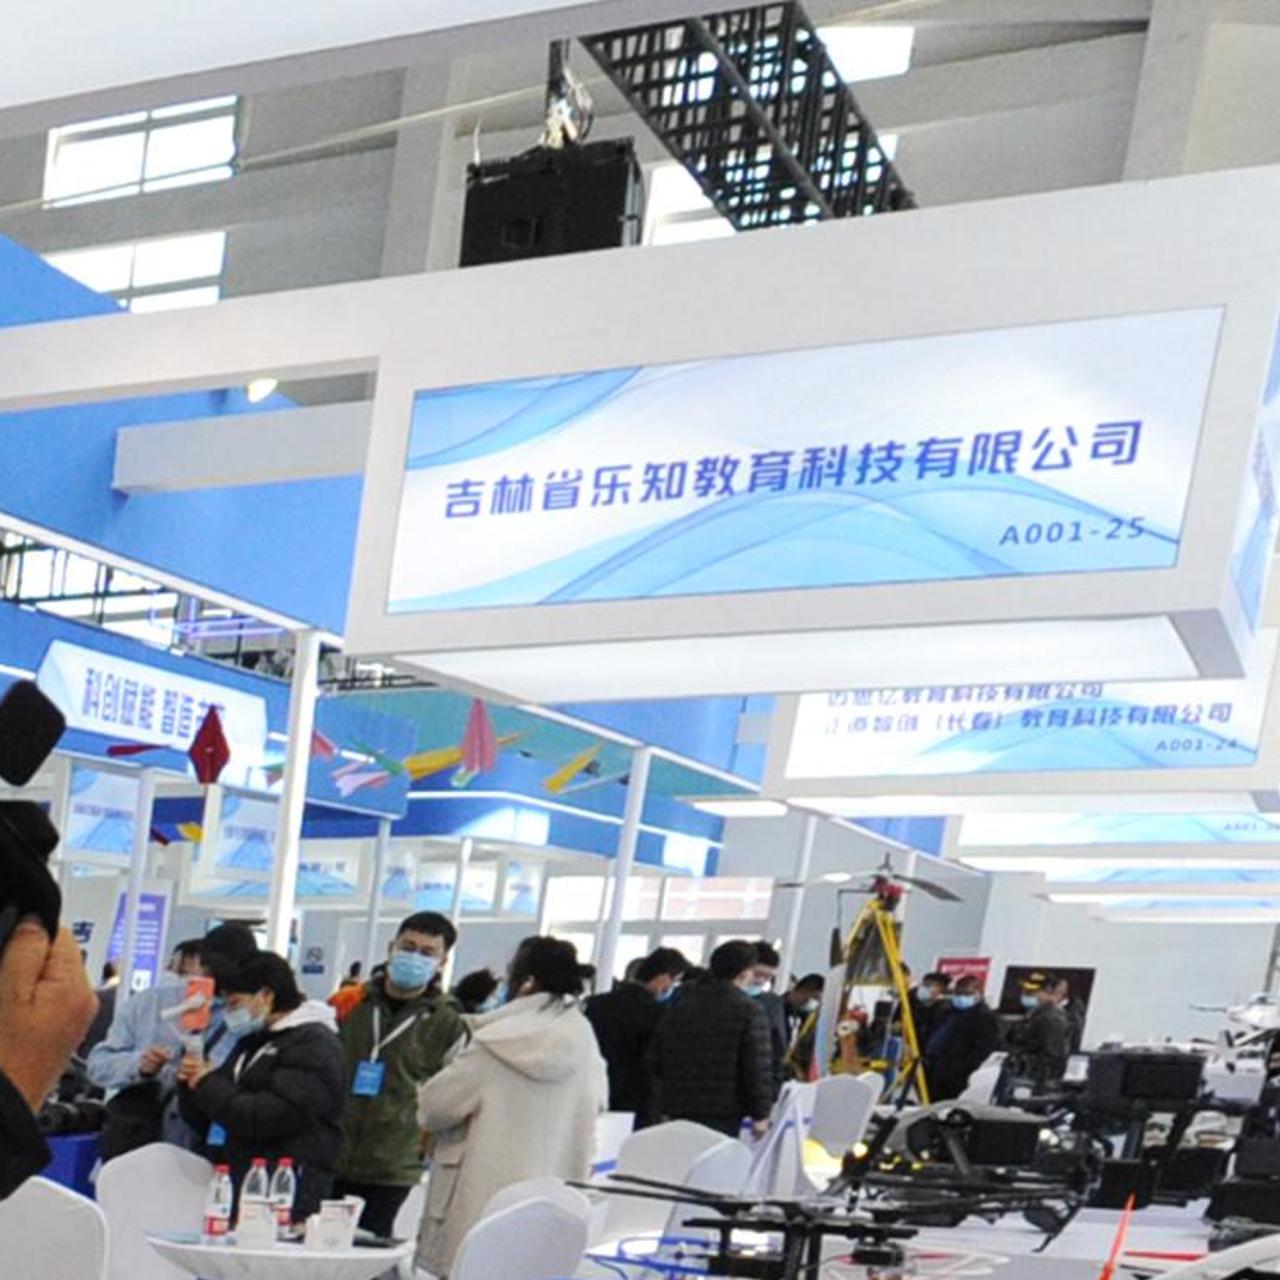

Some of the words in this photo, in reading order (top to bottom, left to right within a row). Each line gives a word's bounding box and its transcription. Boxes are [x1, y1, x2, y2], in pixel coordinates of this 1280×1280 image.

[443, 419, 1143, 520] 吉林省乐知教育科技有限公司
